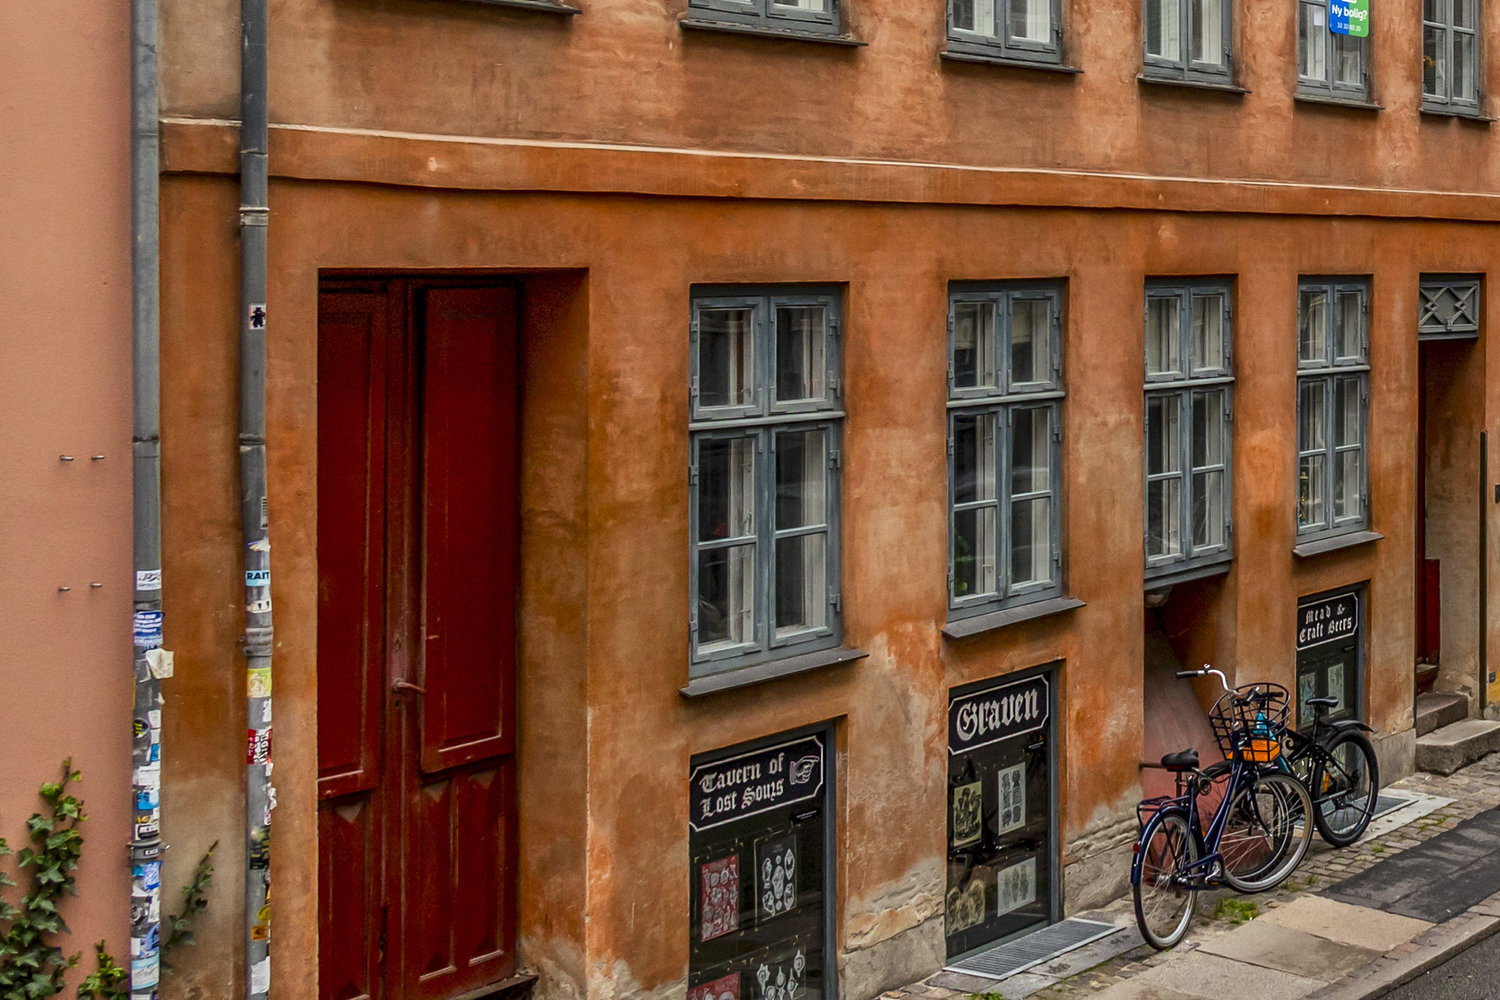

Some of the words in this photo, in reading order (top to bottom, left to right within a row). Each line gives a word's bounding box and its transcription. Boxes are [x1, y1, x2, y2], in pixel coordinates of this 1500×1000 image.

[1332, 4, 1342, 17] Ny
[1344, 7, 1367, 21] bolig?
[1305, 605, 1331, 625] Mead
[956, 688, 1039, 741] Graven
[699, 763, 761, 793] Tavern
[769, 752, 785, 774] of
[699, 791, 737, 820] Lost
